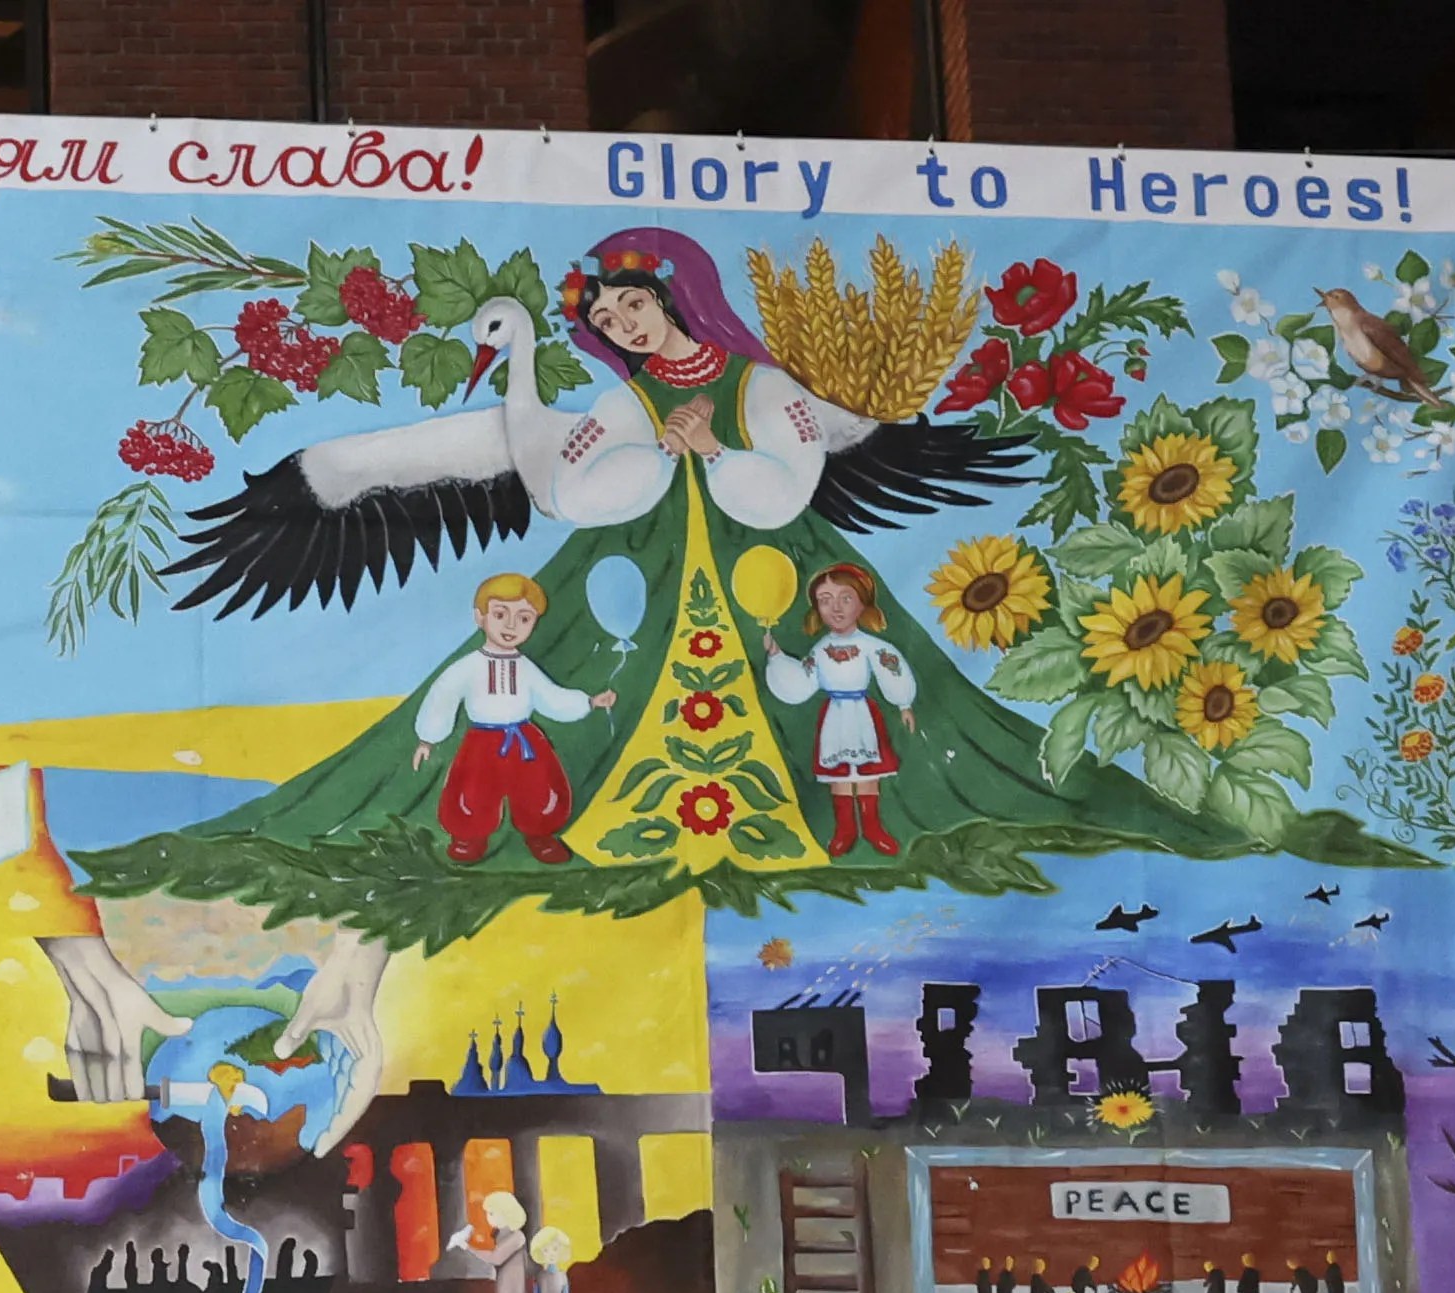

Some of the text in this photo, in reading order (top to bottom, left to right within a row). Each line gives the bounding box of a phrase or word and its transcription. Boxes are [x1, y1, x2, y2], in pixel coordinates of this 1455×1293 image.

[169, 131, 484, 195] слава!
[607, 140, 1413, 224] Glory to Heroes!
[1065, 1187, 1192, 1216] PEACE
